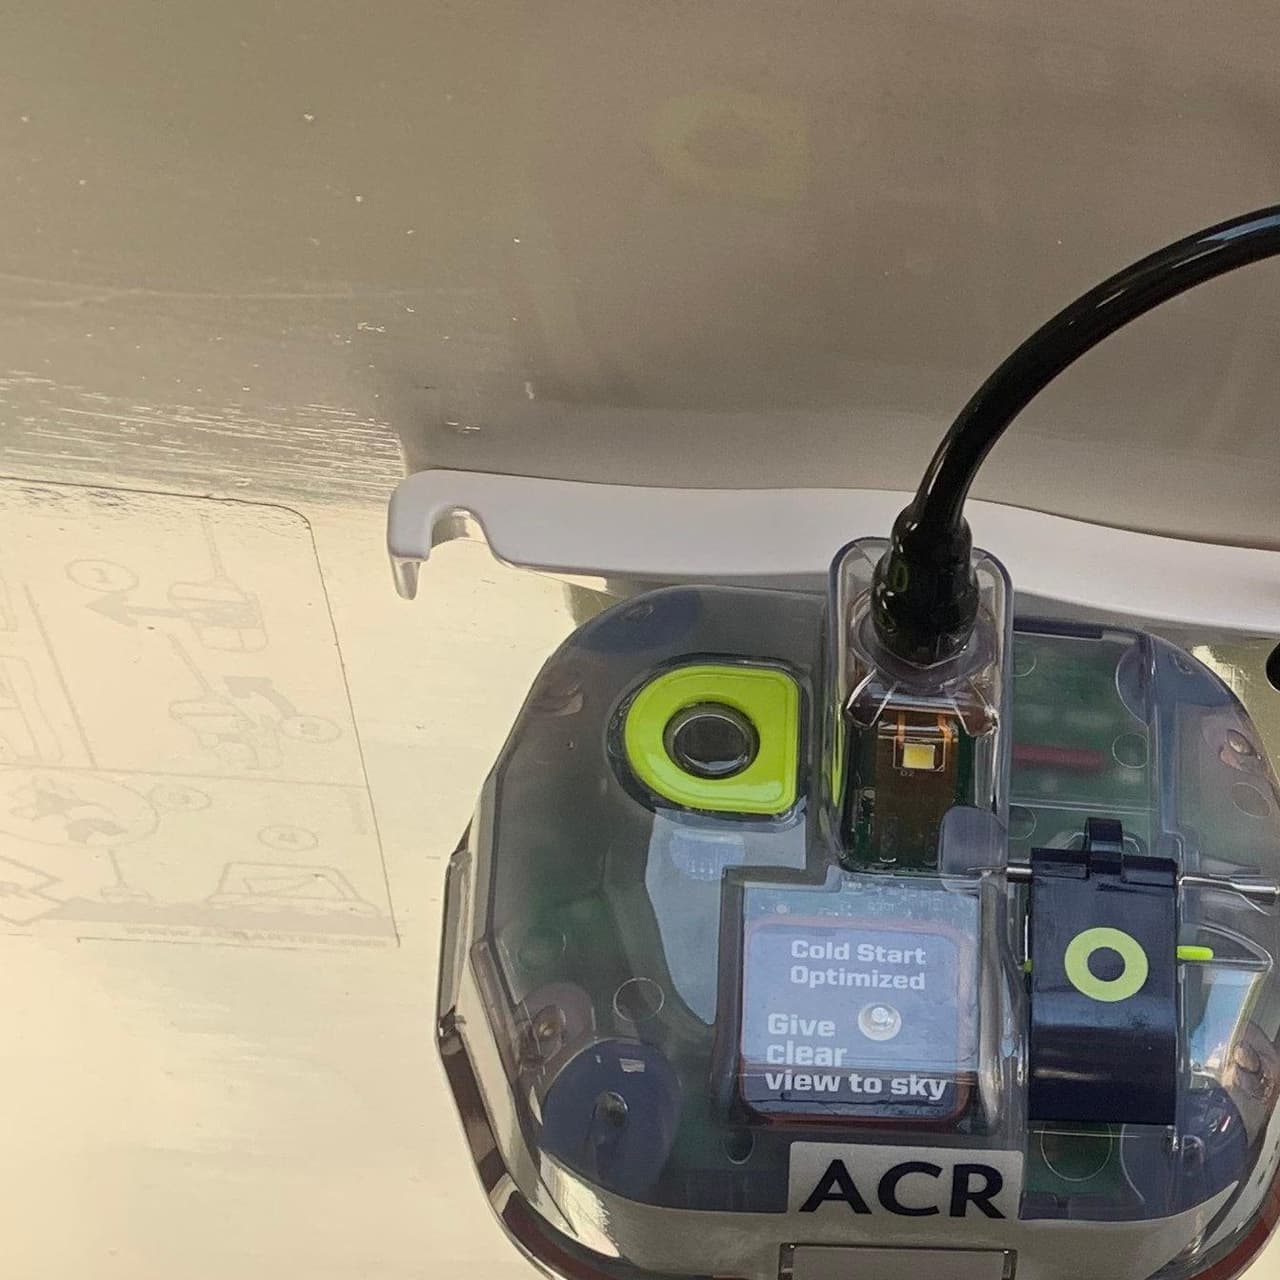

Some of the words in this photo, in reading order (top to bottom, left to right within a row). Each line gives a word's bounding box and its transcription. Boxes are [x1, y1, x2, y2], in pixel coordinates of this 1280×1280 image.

[790, 939, 849, 961] Cold
[857, 943, 927, 965] Start
[790, 965, 926, 990] Optimized
[767, 1012, 836, 1037] Give
[766, 1040, 847, 1067] clear
[764, 1069, 841, 1092] view
[850, 1073, 882, 1094] to
[890, 1073, 947, 1101] sky
[798, 1158, 1006, 1219] ACR
